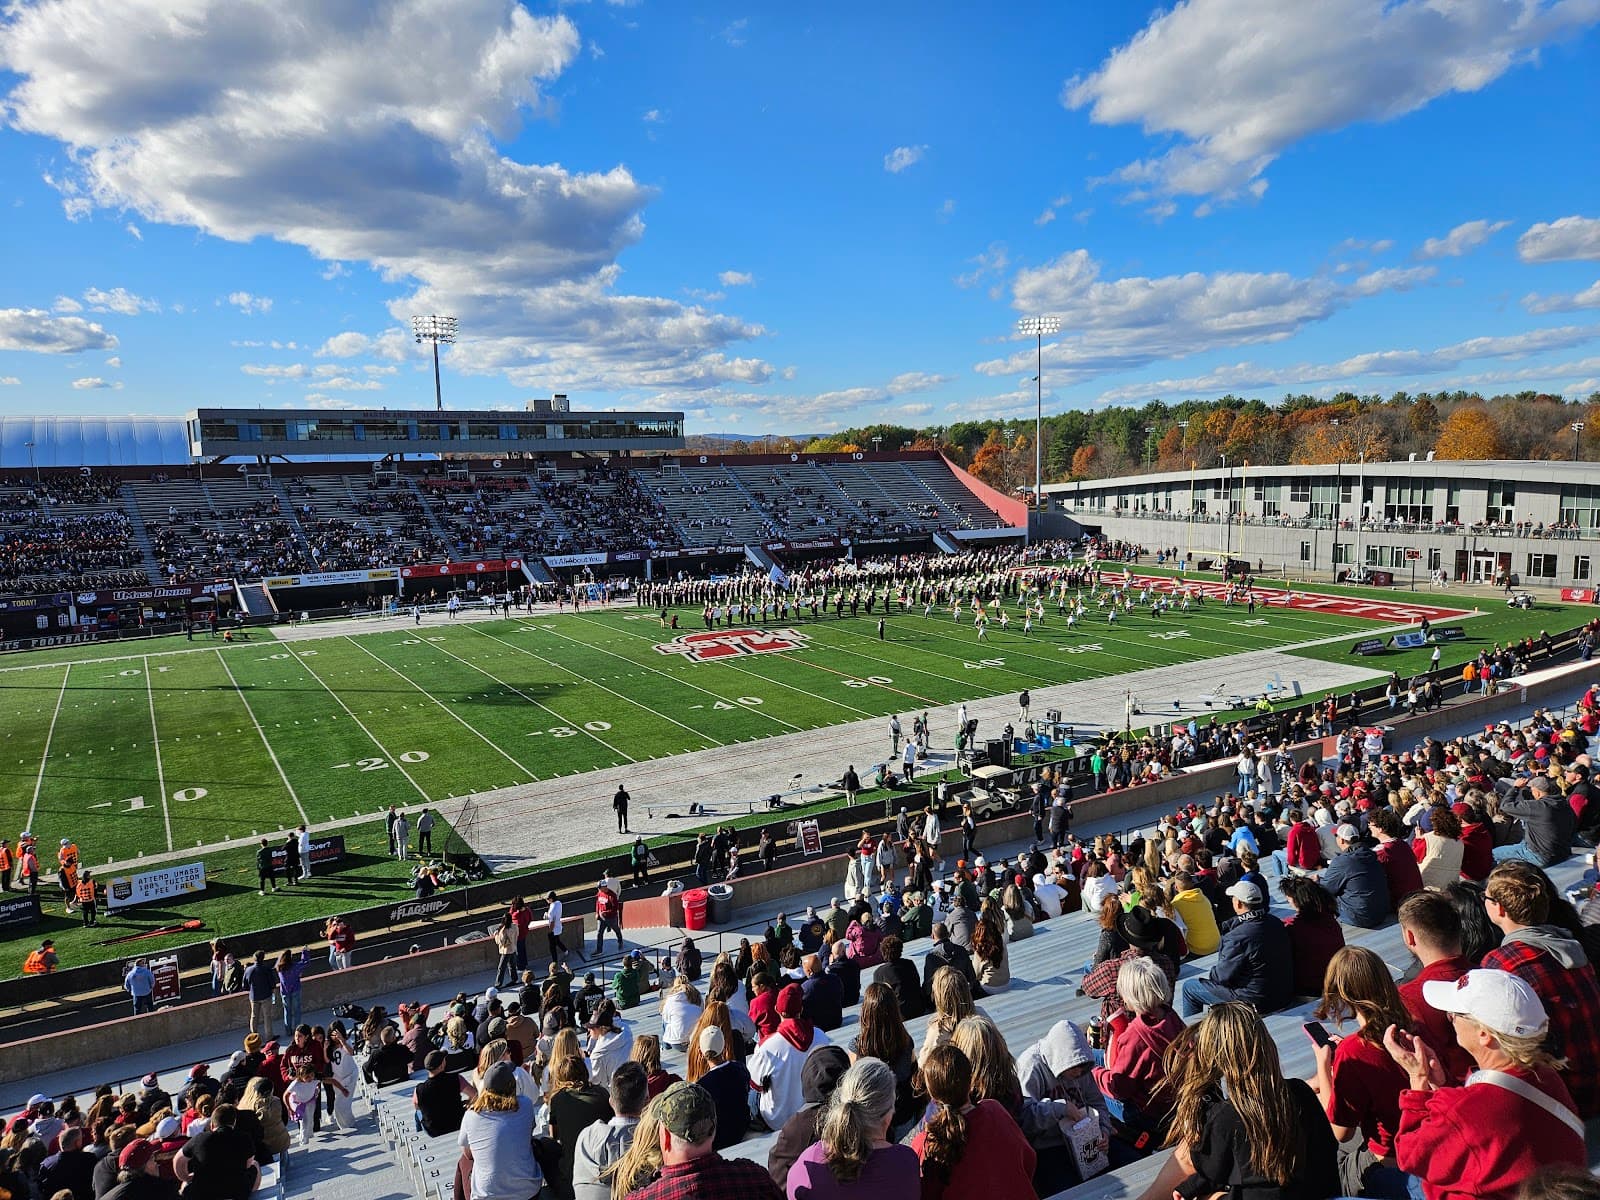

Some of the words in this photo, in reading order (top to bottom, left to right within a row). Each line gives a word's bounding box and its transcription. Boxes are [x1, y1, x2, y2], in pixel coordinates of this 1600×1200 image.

[602, 458, 610, 466] 7
[699, 456, 708, 464] 8
[790, 453, 799, 462] 9
[236, 464, 248, 473] 4
[373, 462, 383, 471] 5
[492, 460, 502, 468] 6
[79, 466, 92, 477] 3
[12, 599, 37, 607] TODAY!
[31, 633, 99, 647] FOOTBALL
[841, 676, 894, 689] 50
[712, 696, 764, 712] 40
[547, 721, 612, 738] 30
[354, 750, 430, 772] 20
[118, 788, 208, 813] 10
[309, 841, 331, 851] Ever?
[271, 850, 288, 858] Bes
[138, 873, 169, 885] ATTEND
[173, 867, 199, 878] UMASS
[165, 873, 200, 886] TUITION
[155, 887, 169, 896] FEE
[0, 901, 33, 912] Brigham
[390, 900, 443, 921] #FLAGSHIP
